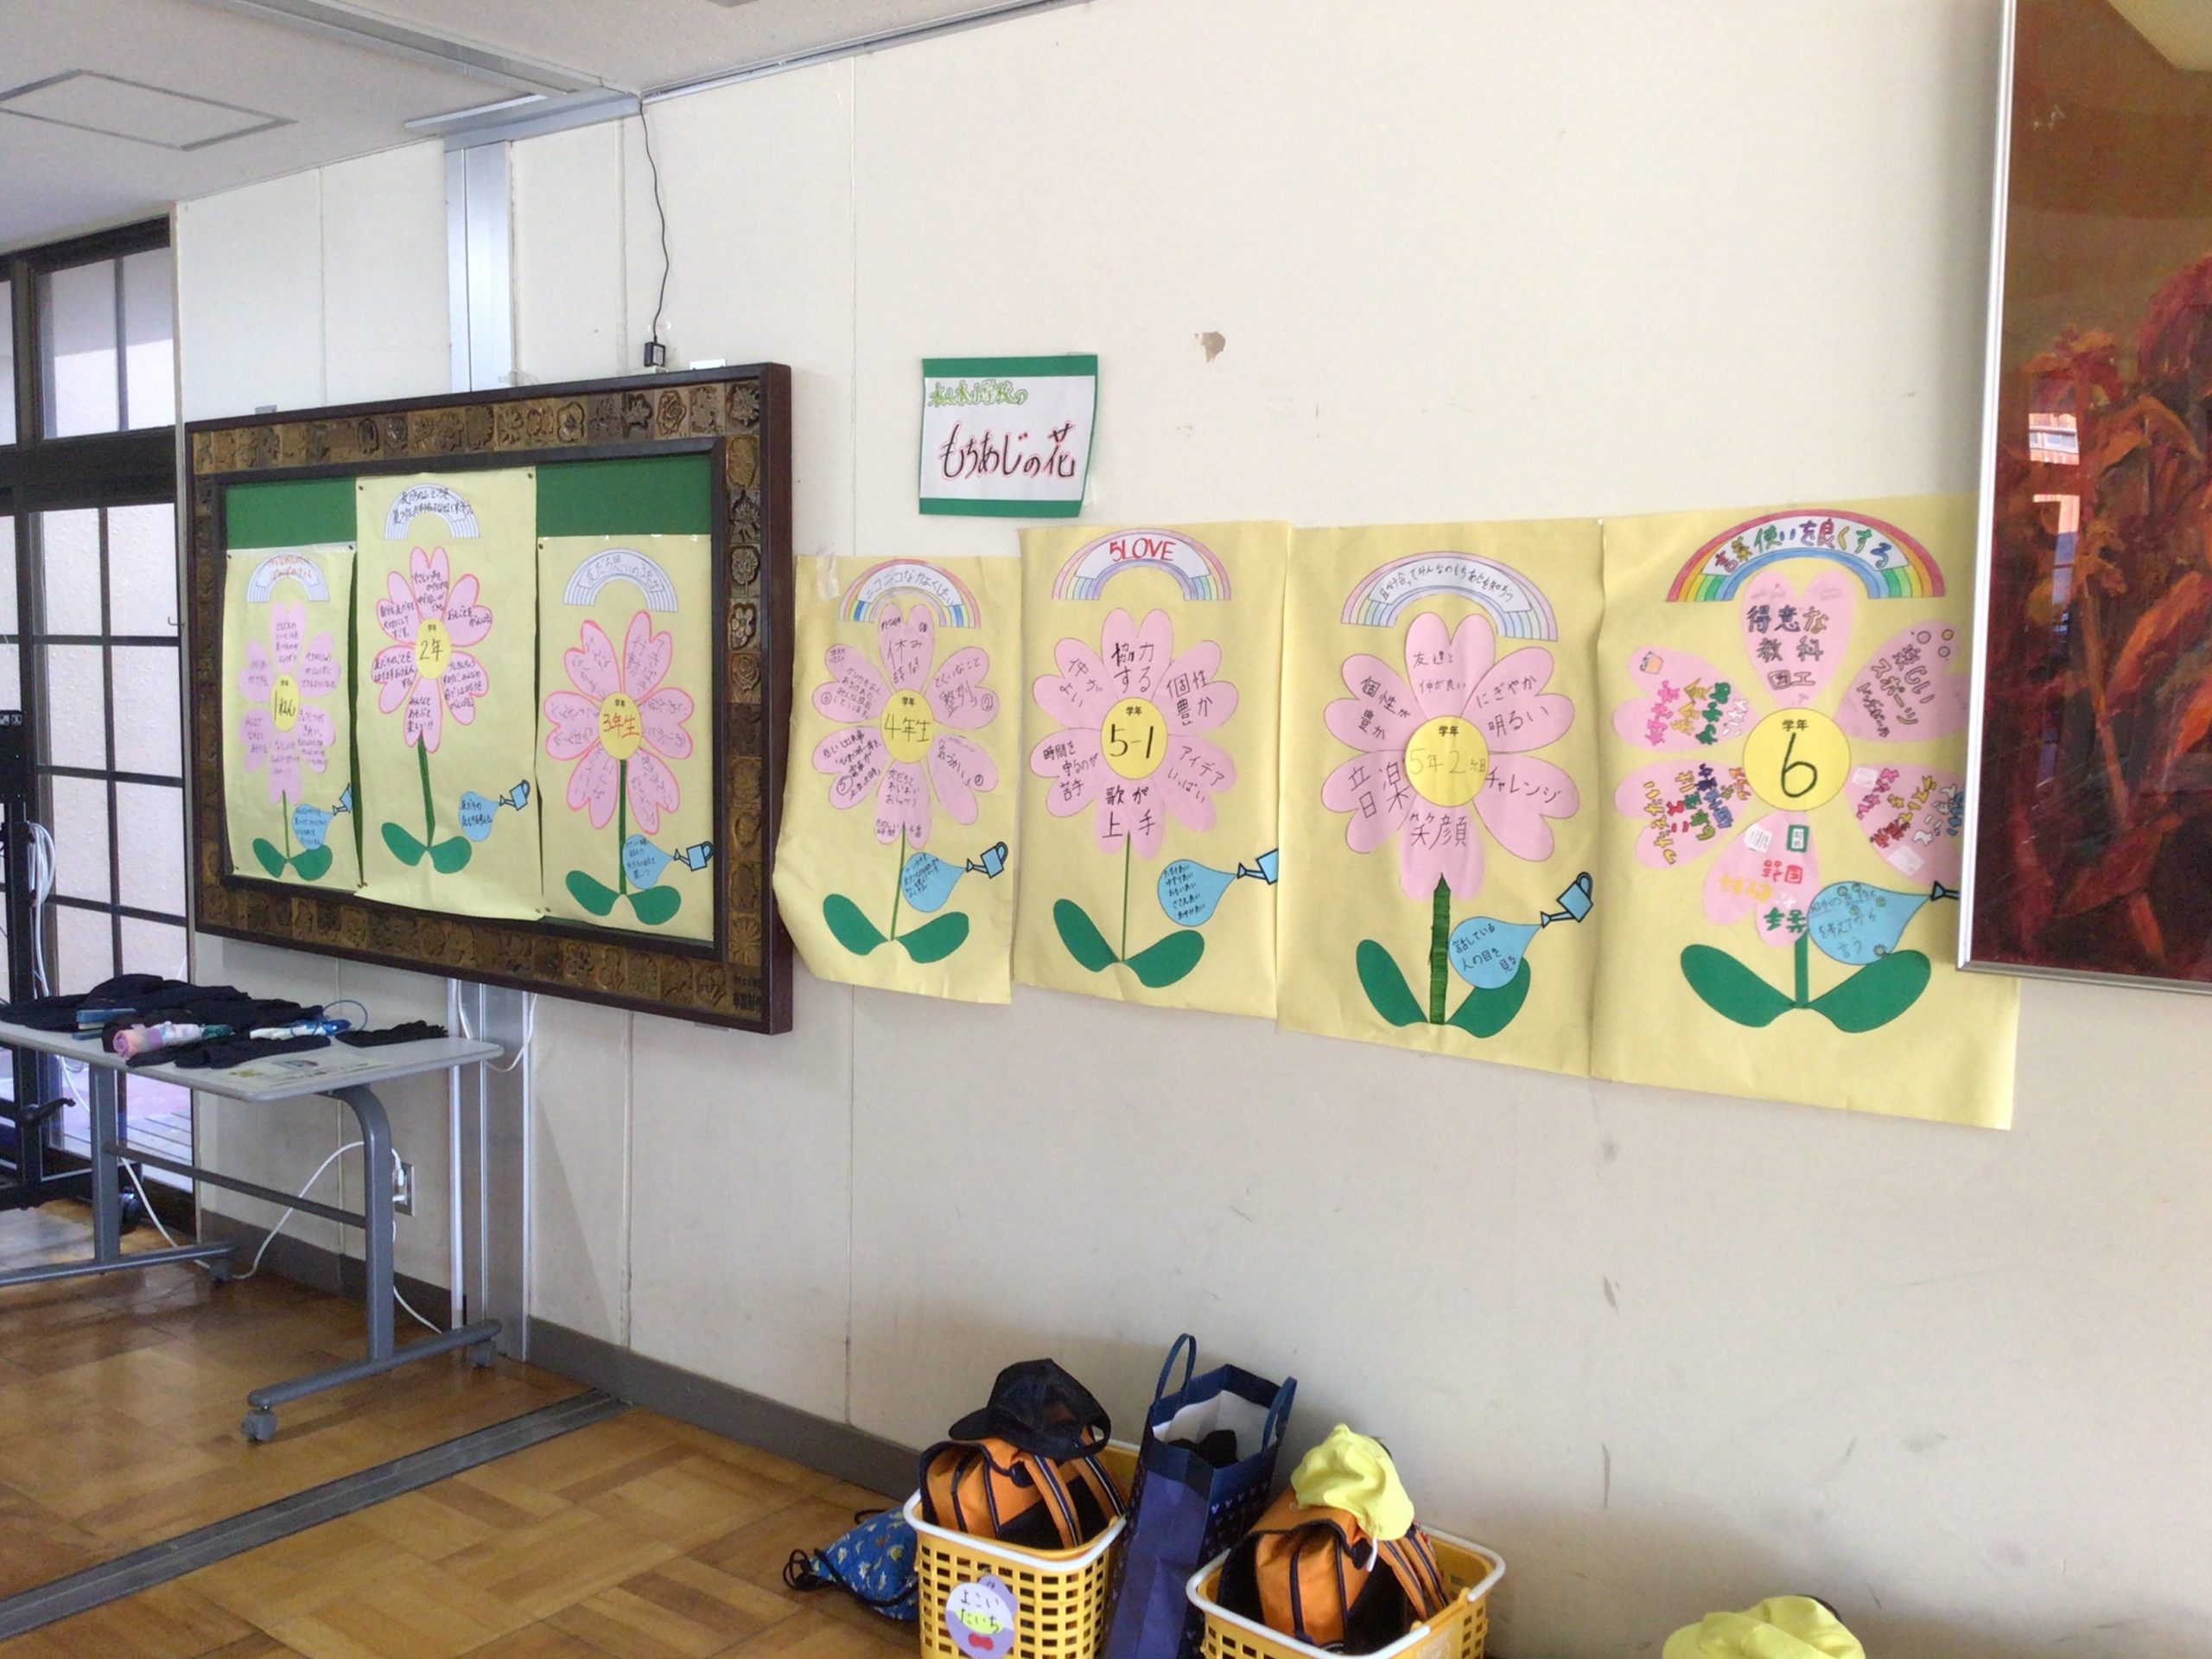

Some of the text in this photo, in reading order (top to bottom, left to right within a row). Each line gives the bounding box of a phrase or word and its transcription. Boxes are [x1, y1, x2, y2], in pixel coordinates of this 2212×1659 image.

[940, 420, 1077, 480] もちあじの花
[1109, 537, 1177, 563] 5LOVE
[1714, 519, 1891, 572] 言葉使いを良くする
[866, 569, 954, 605] ニコニコなかよくしたい
[1745, 604, 1830, 635] 得意な
[419, 639, 444, 662] 2年
[1111, 642, 1154, 667] 協力
[1413, 650, 1455, 666] 友達と
[1756, 638, 1824, 664] 教科
[1114, 666, 1152, 694] する
[1166, 670, 1210, 698] 個性
[1419, 678, 1466, 694] 仲が良い
[1891, 643, 1936, 705] 楽しい
[902, 696, 915, 707] 学年
[1476, 675, 1538, 709] にぎやか
[1870, 658, 1920, 726] スポーツ
[1126, 705, 1142, 716] 学年
[1176, 697, 1214, 727] 豊か
[1487, 705, 1550, 738] 明るい
[603, 713, 640, 738] 3年生
[884, 713, 931, 743] 4年生
[1439, 725, 1459, 737] 学年
[1782, 719, 1809, 732] 学年
[1042, 740, 1077, 761] 時間を
[1109, 723, 1154, 759] 5-1
[1179, 746, 1225, 787] アイデア
[1408, 748, 1486, 775] 5年2組
[1781, 732, 1818, 799] 6
[1059, 779, 1084, 802] 苦手
[1105, 785, 1150, 805] 歌が
[1167, 766, 1206, 804] いっぱい
[1348, 761, 1410, 819] 音楽
[1485, 766, 1563, 804] チャレンジ
[1102, 808, 1156, 838] 上手
[1409, 812, 1468, 850] 笑顔
[1761, 859, 1804, 885] 国語
[1452, 922, 1497, 955] 話している
[1837, 936, 1862, 959] 言う
[1460, 946, 1503, 971] 人の目を
[1499, 955, 1518, 973] 見る
[960, 1589, 1000, 1609] よこい
[960, 1607, 1000, 1634] たいち
